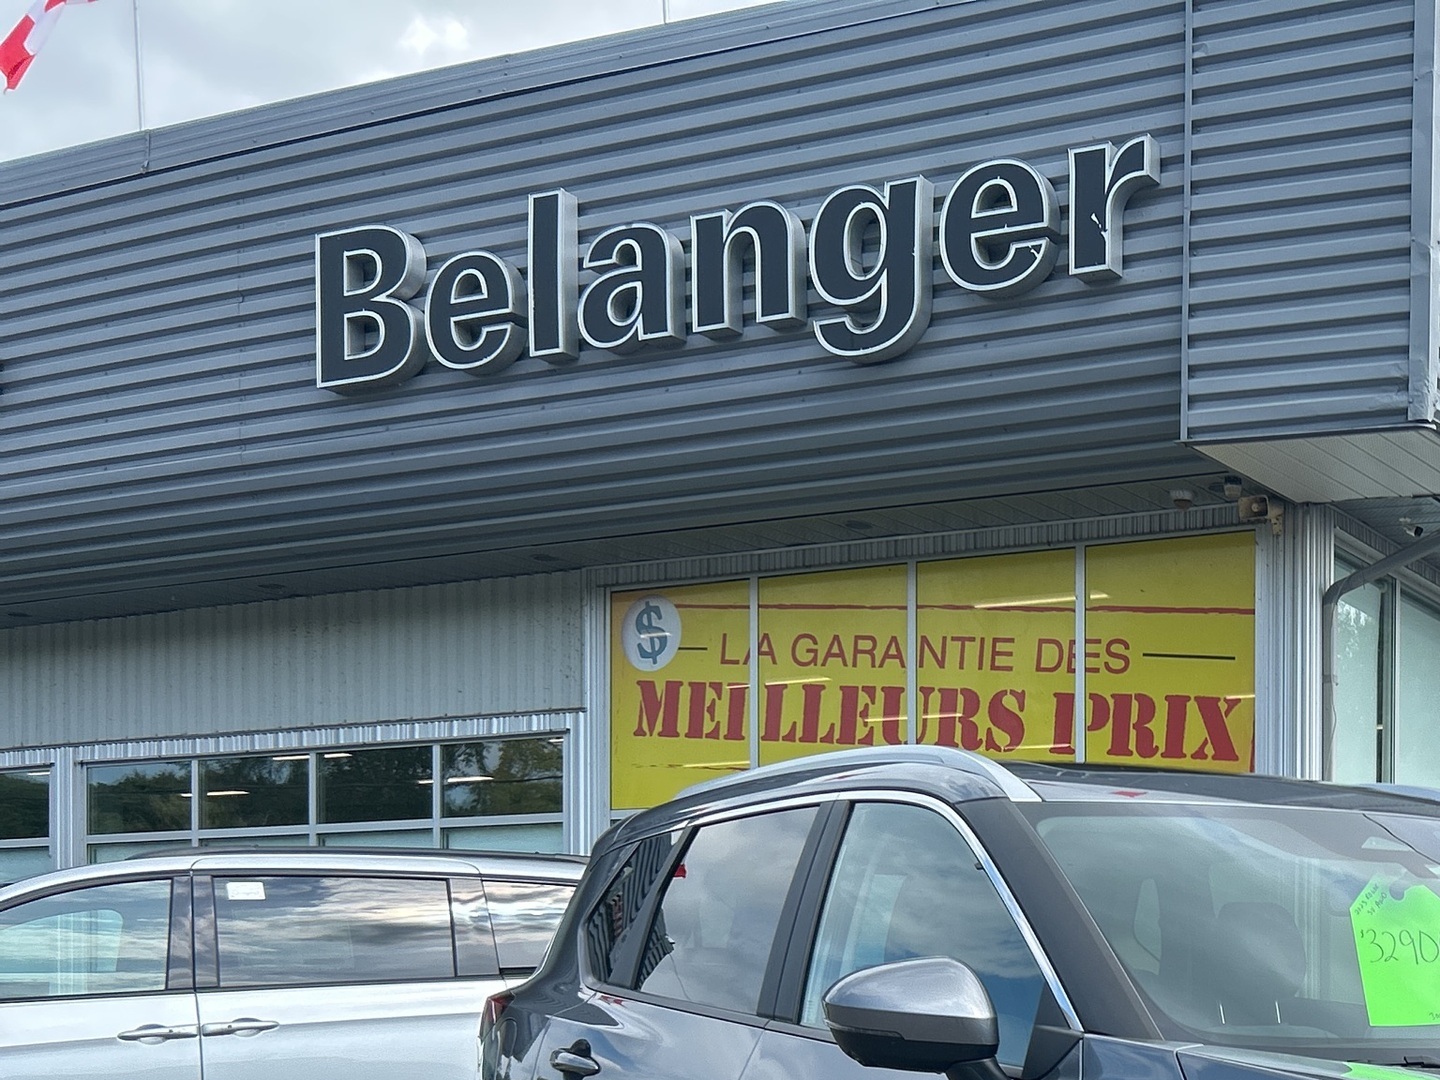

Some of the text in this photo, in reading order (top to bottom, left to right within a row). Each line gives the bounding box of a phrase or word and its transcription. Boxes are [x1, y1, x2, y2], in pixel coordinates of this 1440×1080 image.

[314, 132, 1162, 393] Belanger
[719, 633, 1131, 674] LA GARANTIE DES
[632, 680, 1242, 761] MEILLEURS PRIX
